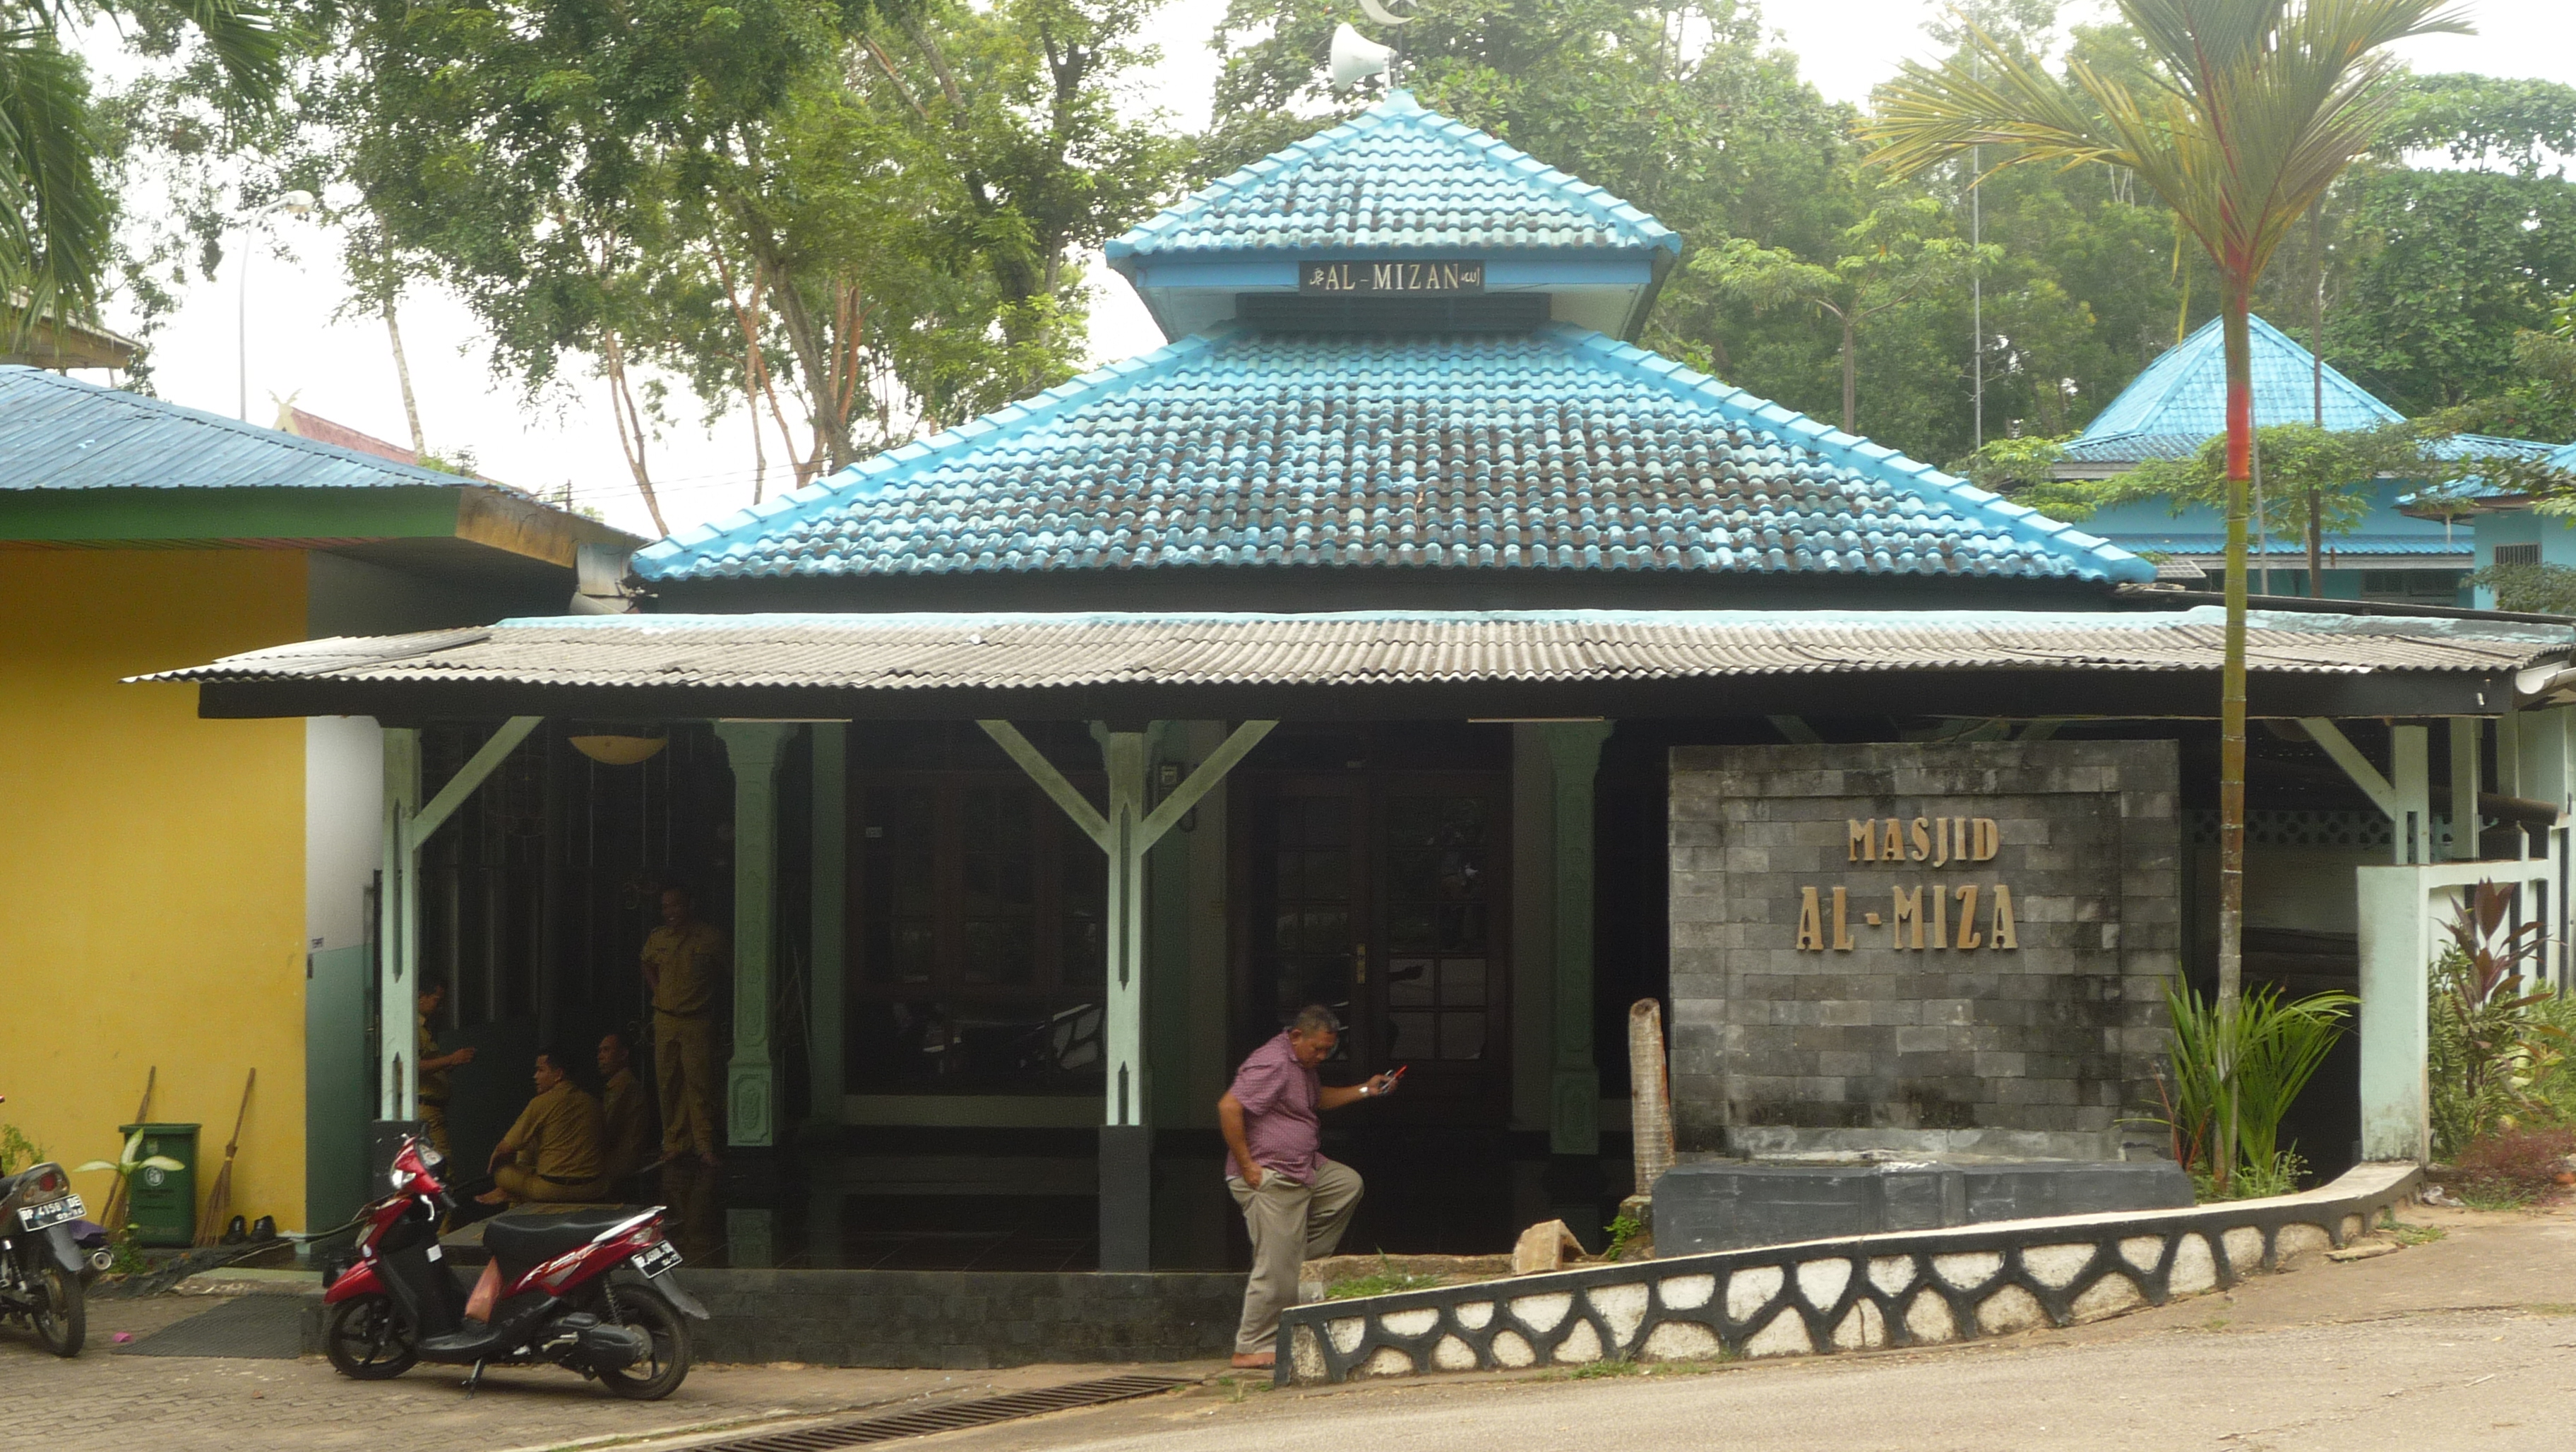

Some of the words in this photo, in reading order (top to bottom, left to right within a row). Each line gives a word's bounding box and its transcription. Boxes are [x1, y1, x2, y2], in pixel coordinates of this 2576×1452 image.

[1847, 817, 1999, 868] MASJID
[18, 1209, 34, 1220] BP
[66, 1196, 82, 1208] DE
